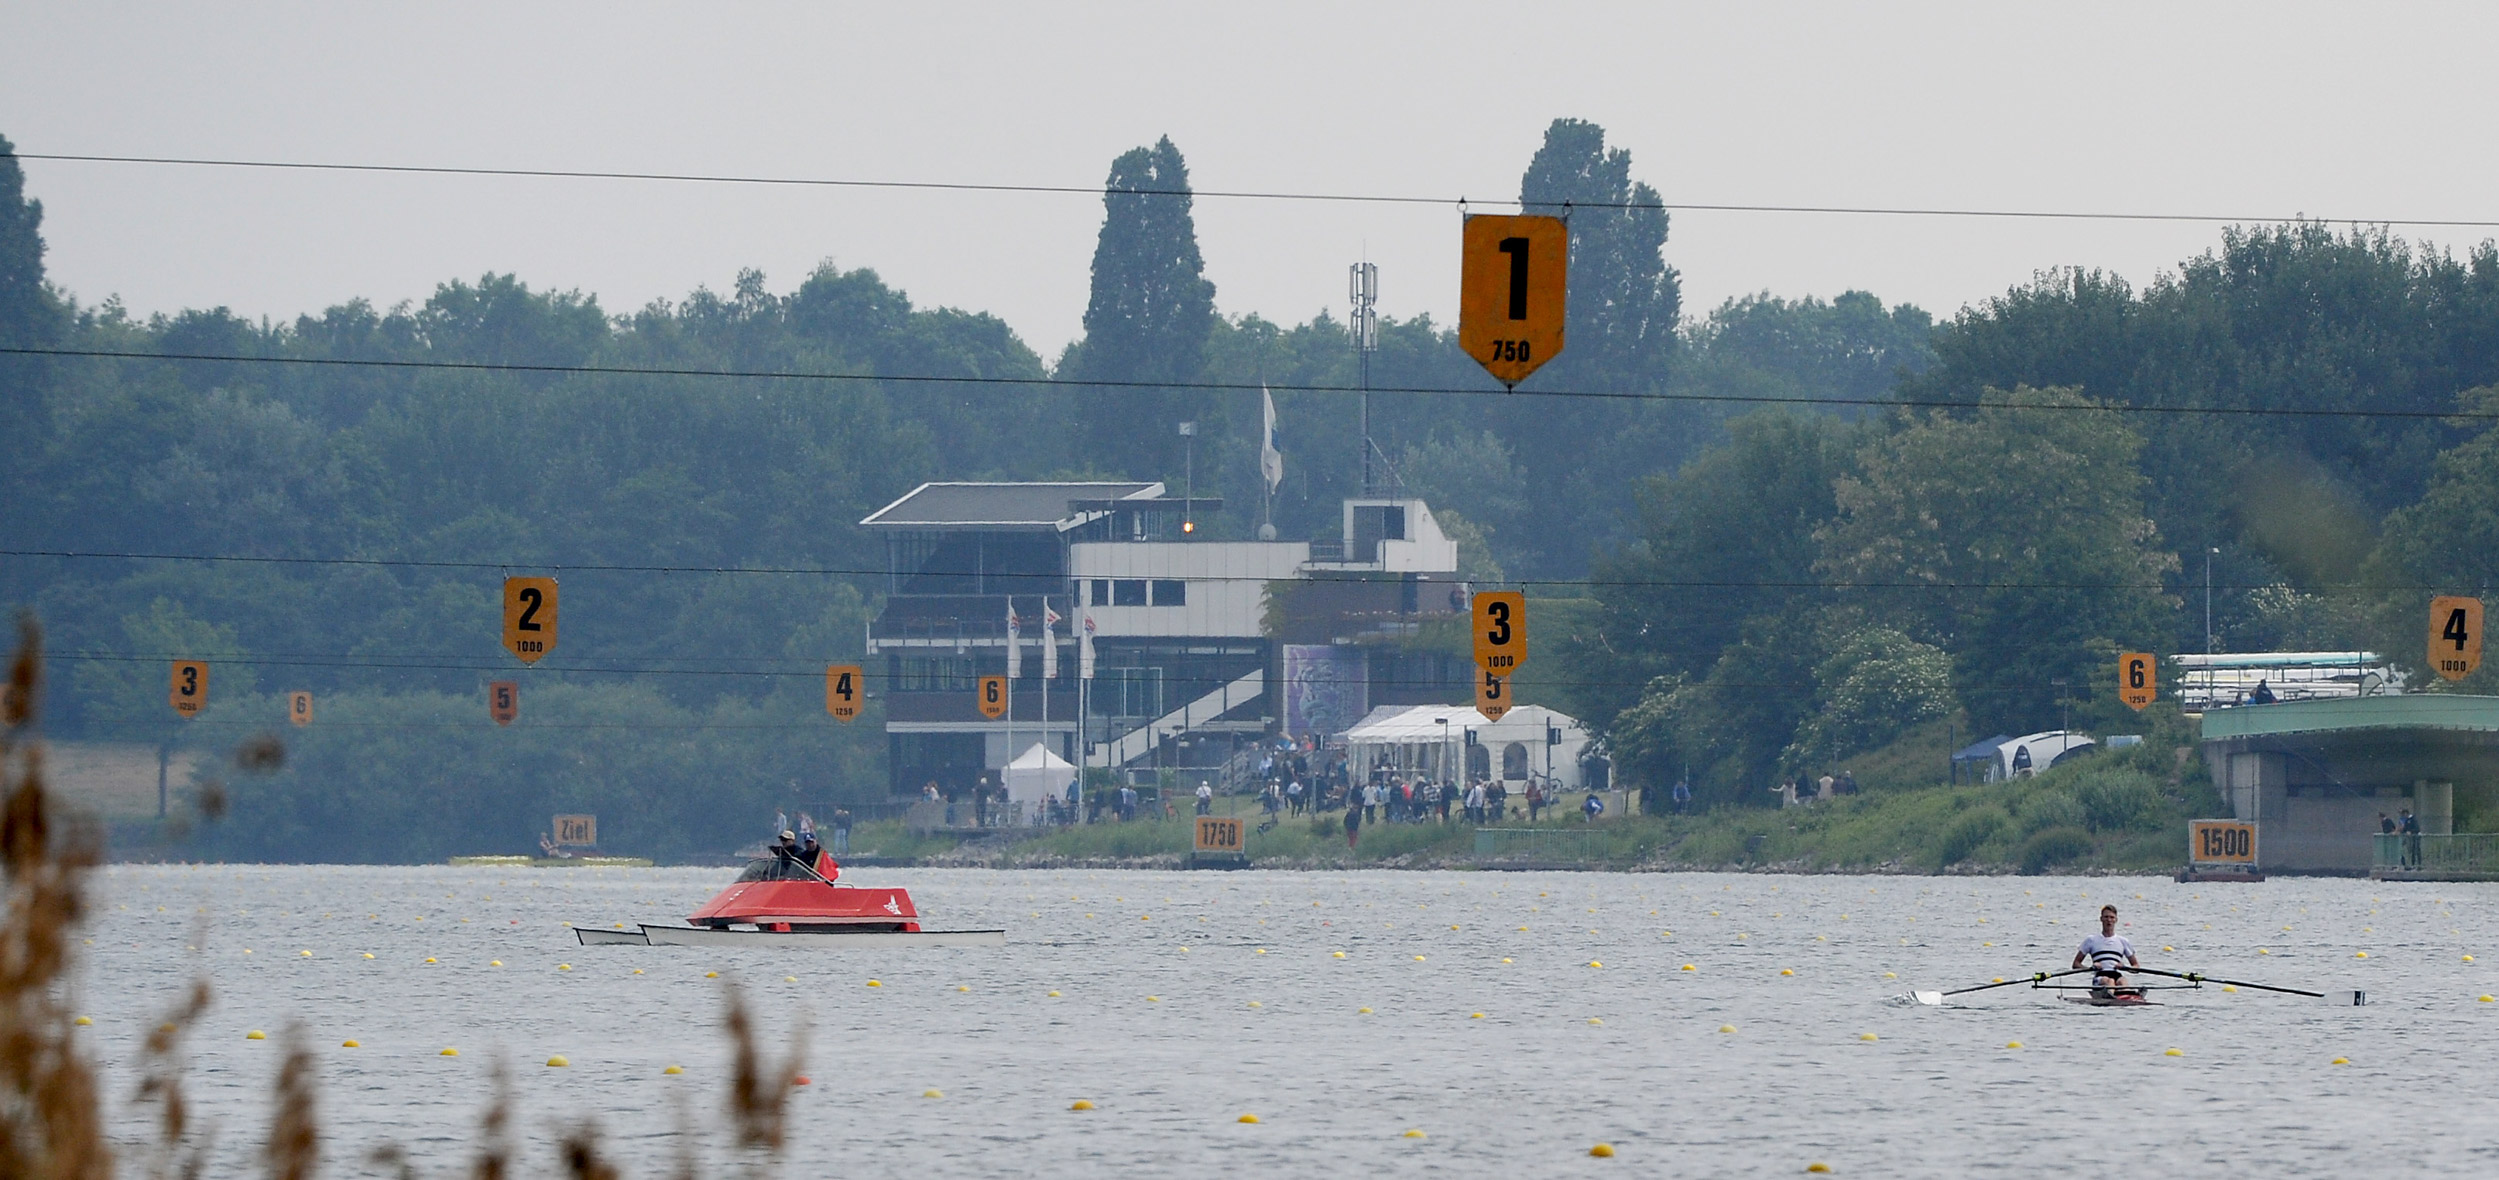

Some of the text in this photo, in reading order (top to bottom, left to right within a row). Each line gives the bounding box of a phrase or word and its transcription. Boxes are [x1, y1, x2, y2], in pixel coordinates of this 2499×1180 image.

[1499, 237, 1529, 320] 1
[1493, 340, 1530, 362] 750
[518, 587, 542, 631] 2
[1488, 601, 1510, 645] 3
[2443, 608, 2467, 651] 4
[517, 641, 543, 652] 1000
[1488, 655, 1513, 667] 1000
[2441, 660, 2466, 671] 1000
[181, 666, 197, 696] 3
[1486, 671, 1500, 699] 5
[2129, 659, 2144, 689] 6
[497, 687, 510, 709] 5
[836, 672, 853, 701] 4
[986, 680, 998, 703] 6
[296, 695, 307, 714] 6
[836, 707, 853, 716] 1250
[562, 820, 589, 841] Ziel
[1202, 822, 1236, 846] 1750
[2201, 828, 2249, 857] 1500
